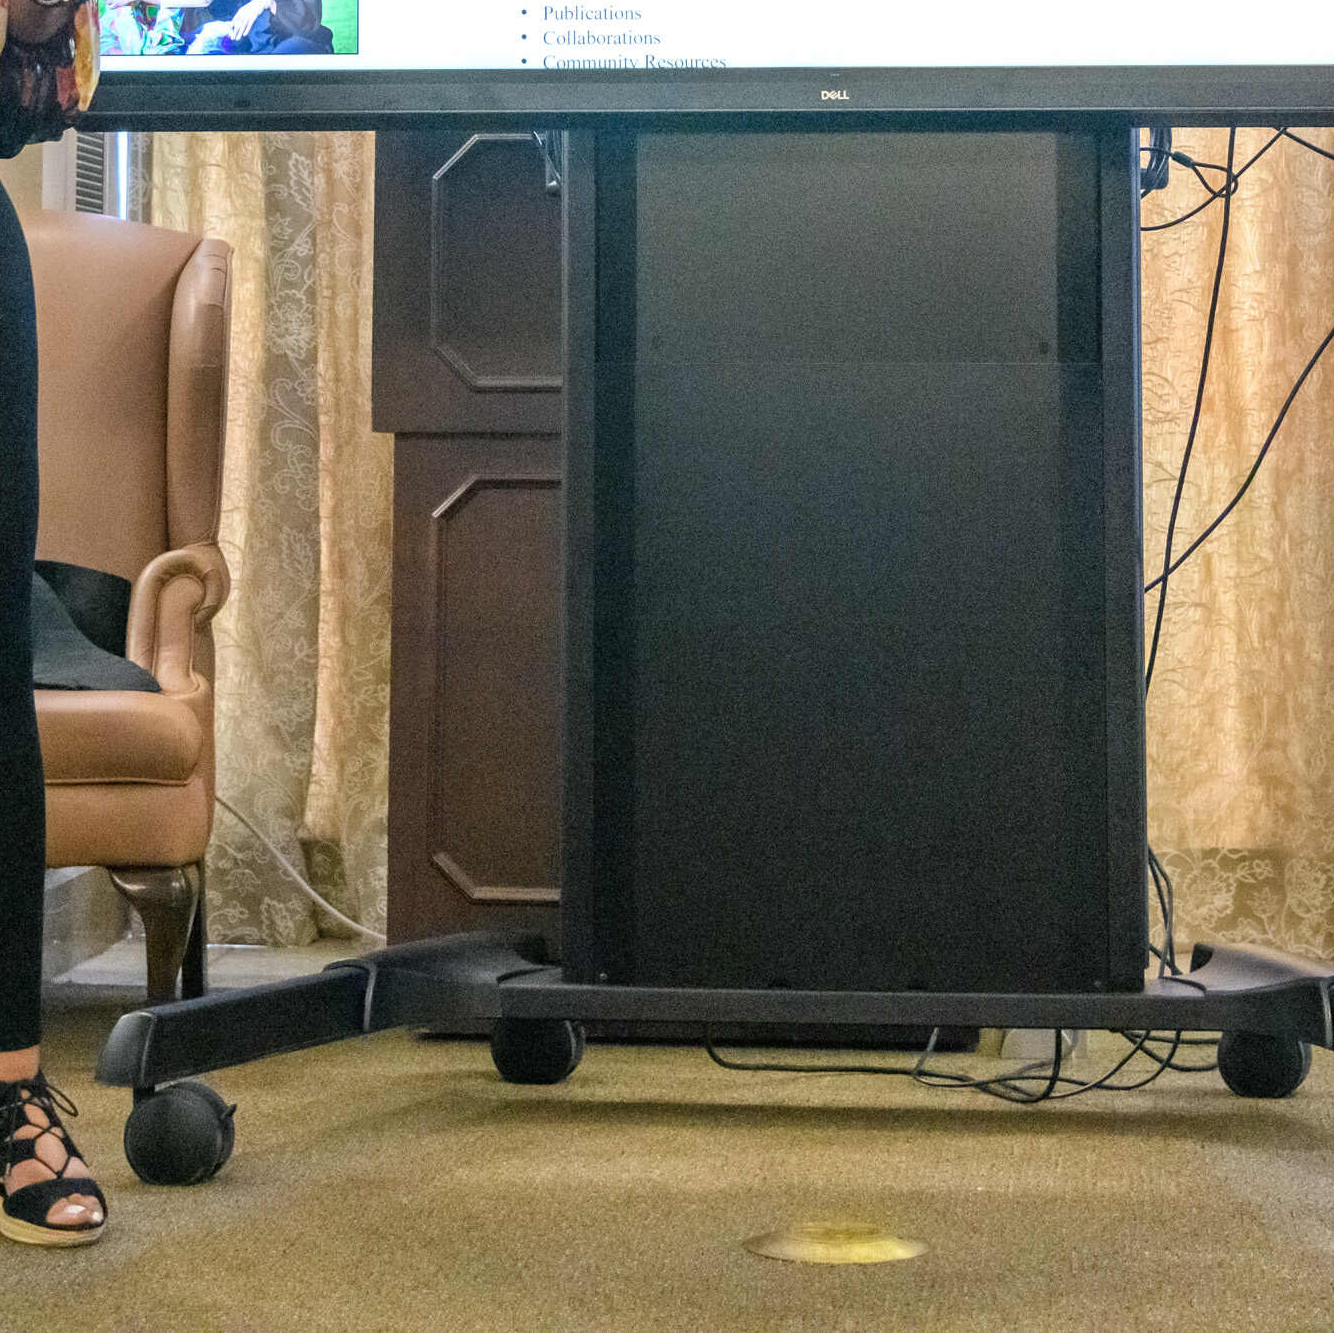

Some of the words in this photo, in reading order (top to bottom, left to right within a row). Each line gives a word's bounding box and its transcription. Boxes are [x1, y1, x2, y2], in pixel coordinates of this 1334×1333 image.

[544, 4, 641, 21] Publications
[543, 30, 661, 45] Collaborations
[820, 90, 851, 100] DELL
